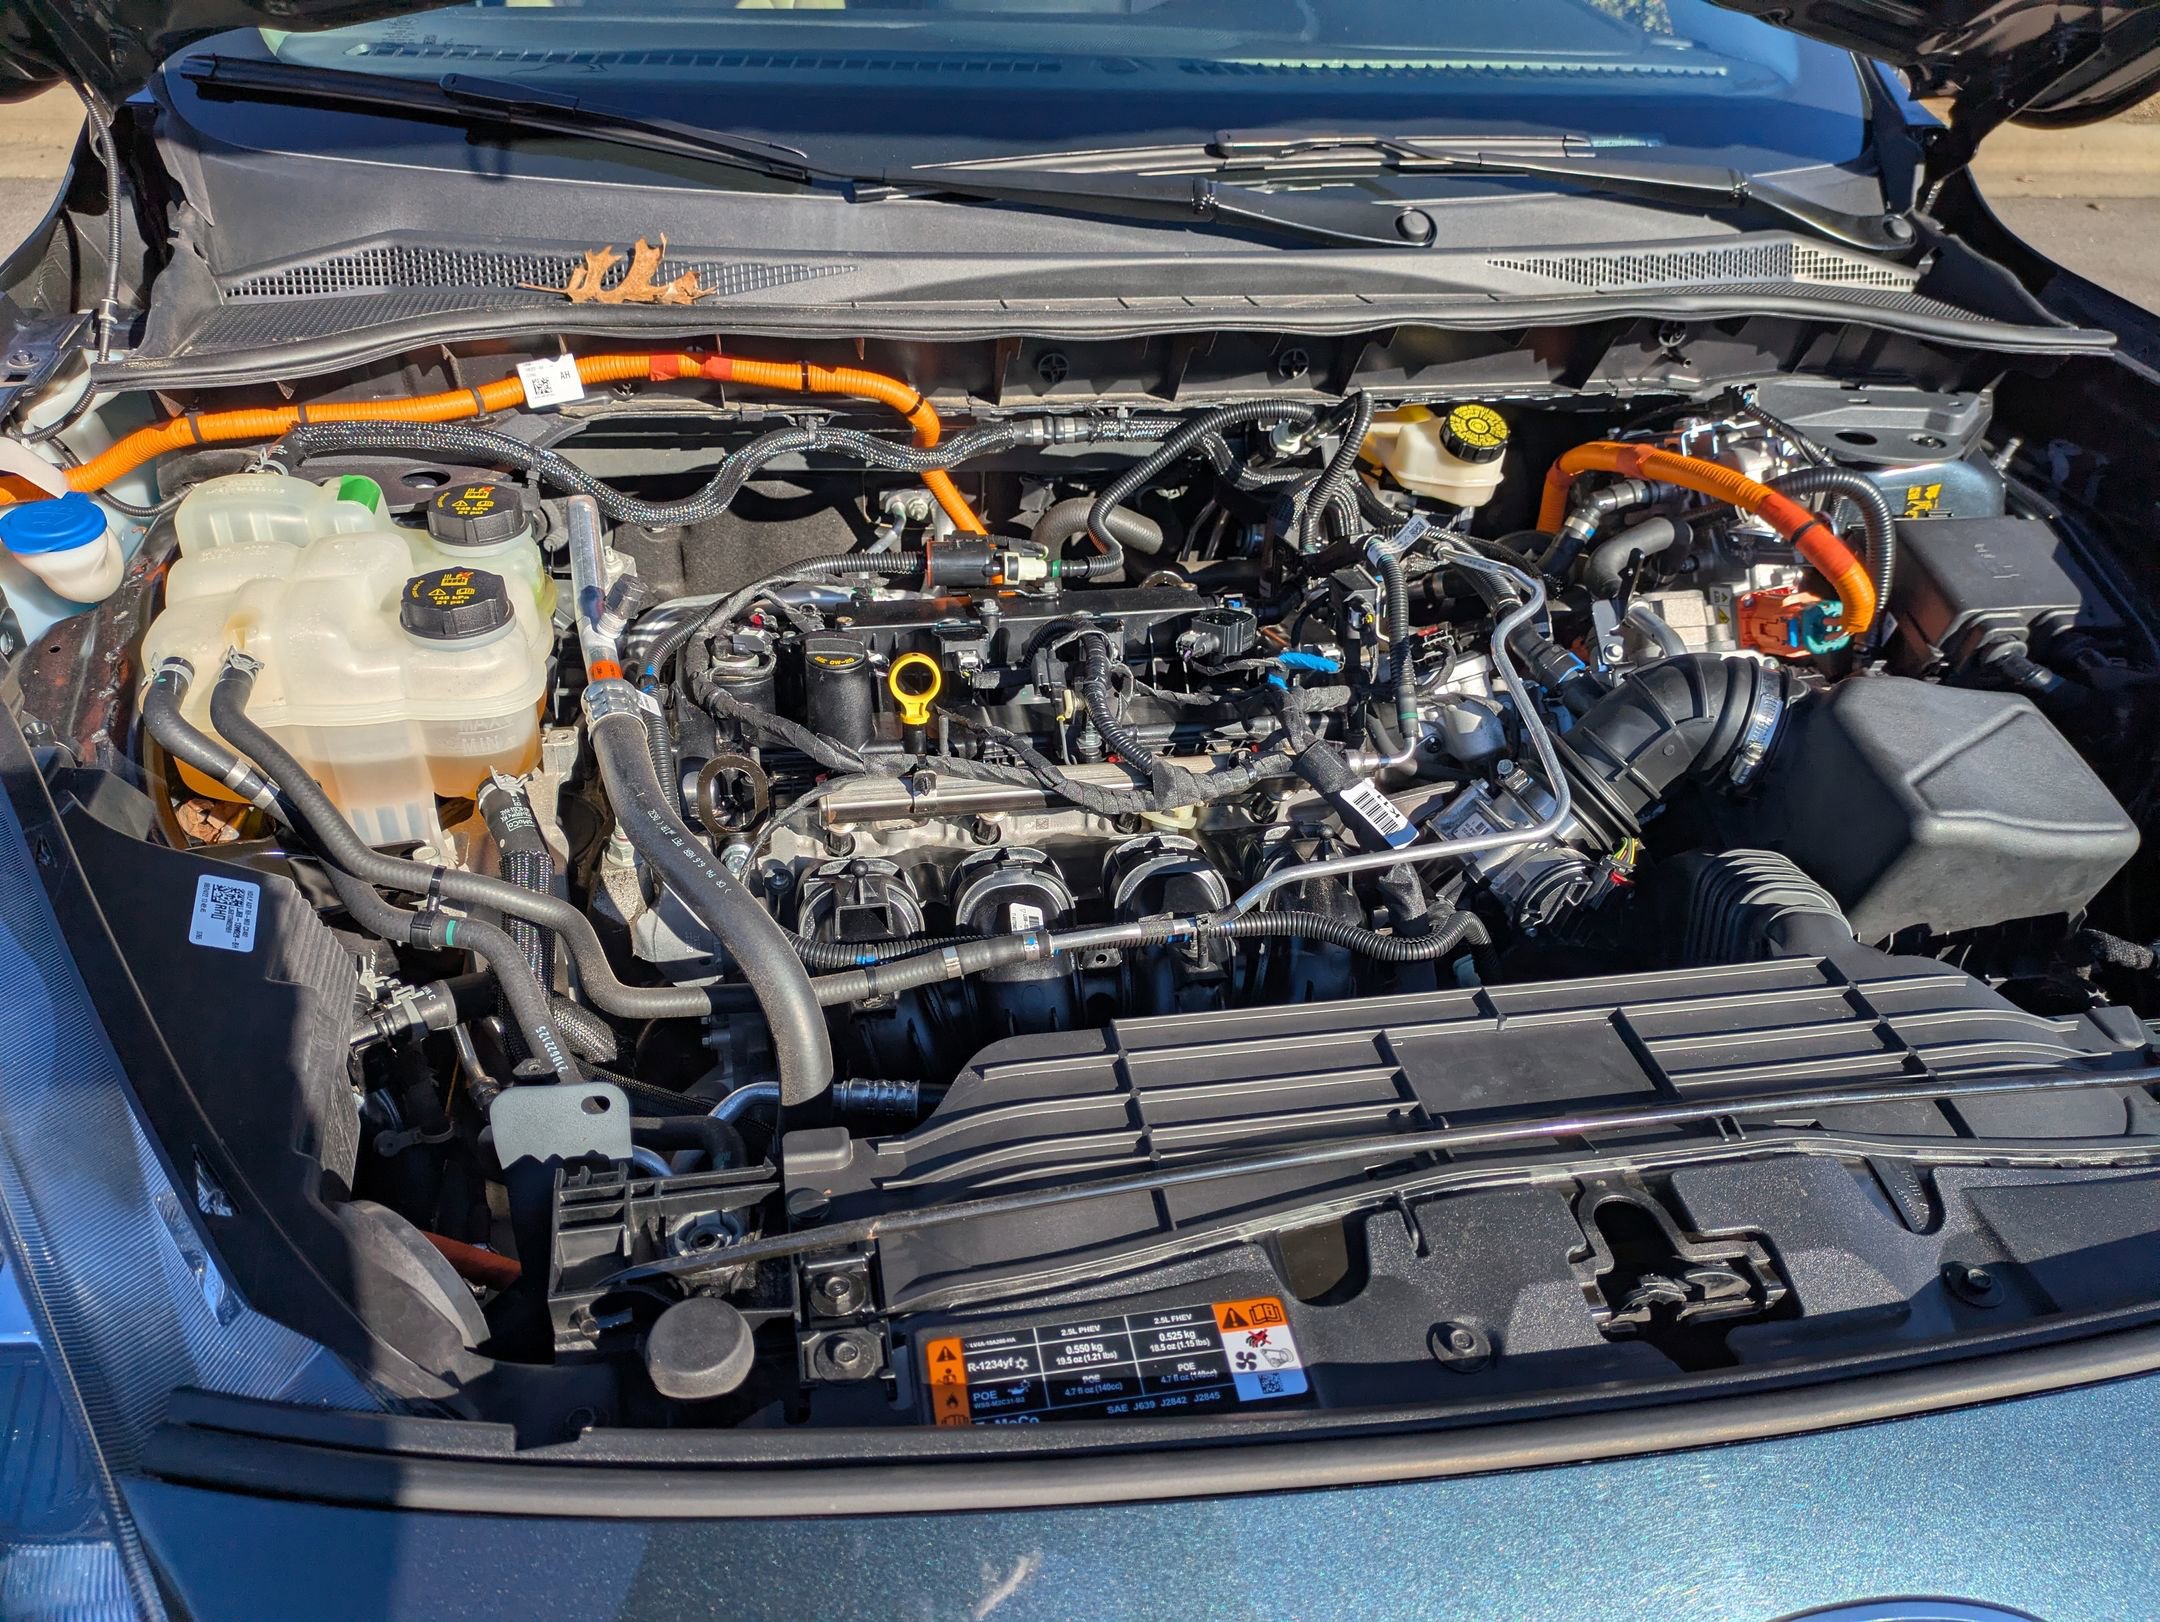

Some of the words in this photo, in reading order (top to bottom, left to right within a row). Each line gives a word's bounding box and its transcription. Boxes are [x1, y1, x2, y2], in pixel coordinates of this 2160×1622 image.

[560, 370, 571, 380] AH
[1171, 1314, 1192, 1322] FHEV
[1060, 1328, 1078, 1336] 2.5L
[1078, 1325, 1100, 1334] PHEV
[1159, 1332, 1183, 1342] 0.525
[1184, 1330, 1196, 1340] kg
[1066, 1344, 1090, 1354] 0.550
[1090, 1342, 1104, 1353] kg
[1150, 1344, 1166, 1352] 18.5
[1176, 1340, 1195, 1351] (1.15
[1195, 1338, 1210, 1347] lbs)
[1056, 1357, 1072, 1365] 19.5
[1084, 1353, 1101, 1363] (1.21
[1102, 1350, 1118, 1360] lbs)
[968, 1357, 1013, 1372] R-1234yf
[1177, 1362, 1196, 1372] POE
[1082, 1374, 1100, 1383] POE
[973, 1390, 998, 1401] POE
[1106, 1404, 1128, 1414] SAE
[1133, 1400, 1156, 1410] J639
[1160, 1396, 1188, 1407] J2842
[1194, 1392, 1221, 1402] J2845
